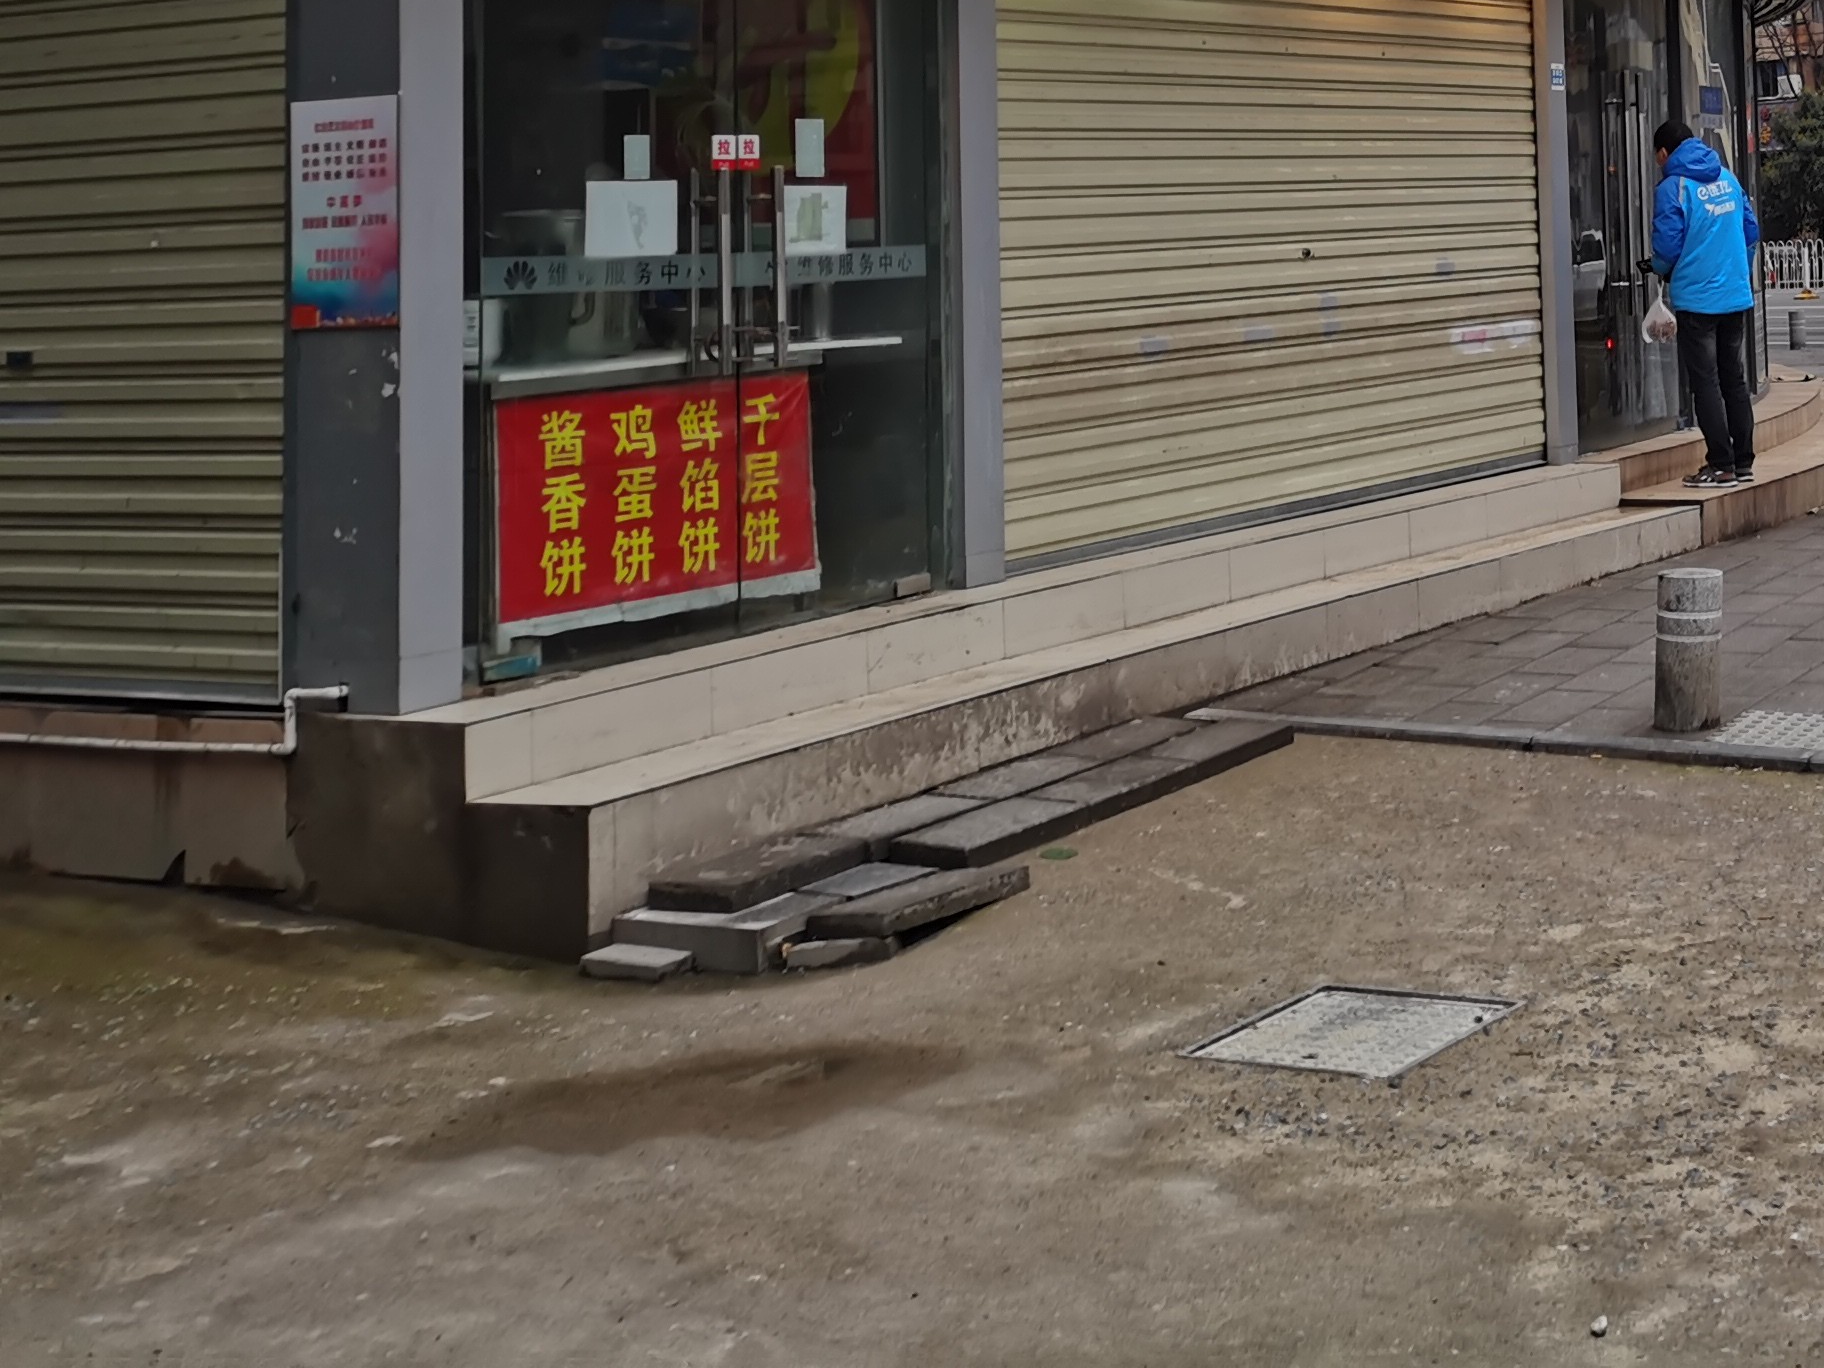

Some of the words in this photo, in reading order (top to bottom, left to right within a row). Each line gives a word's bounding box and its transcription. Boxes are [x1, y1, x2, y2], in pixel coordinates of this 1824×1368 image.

[717, 139, 731, 156] 拉
[743, 138, 755, 155] 拉
[539, 409, 587, 597] 酱香饼
[610, 404, 657, 584] 鸡蛋饼
[676, 399, 722, 574] 鲜馅饼
[742, 393, 780, 563] 千层饼
